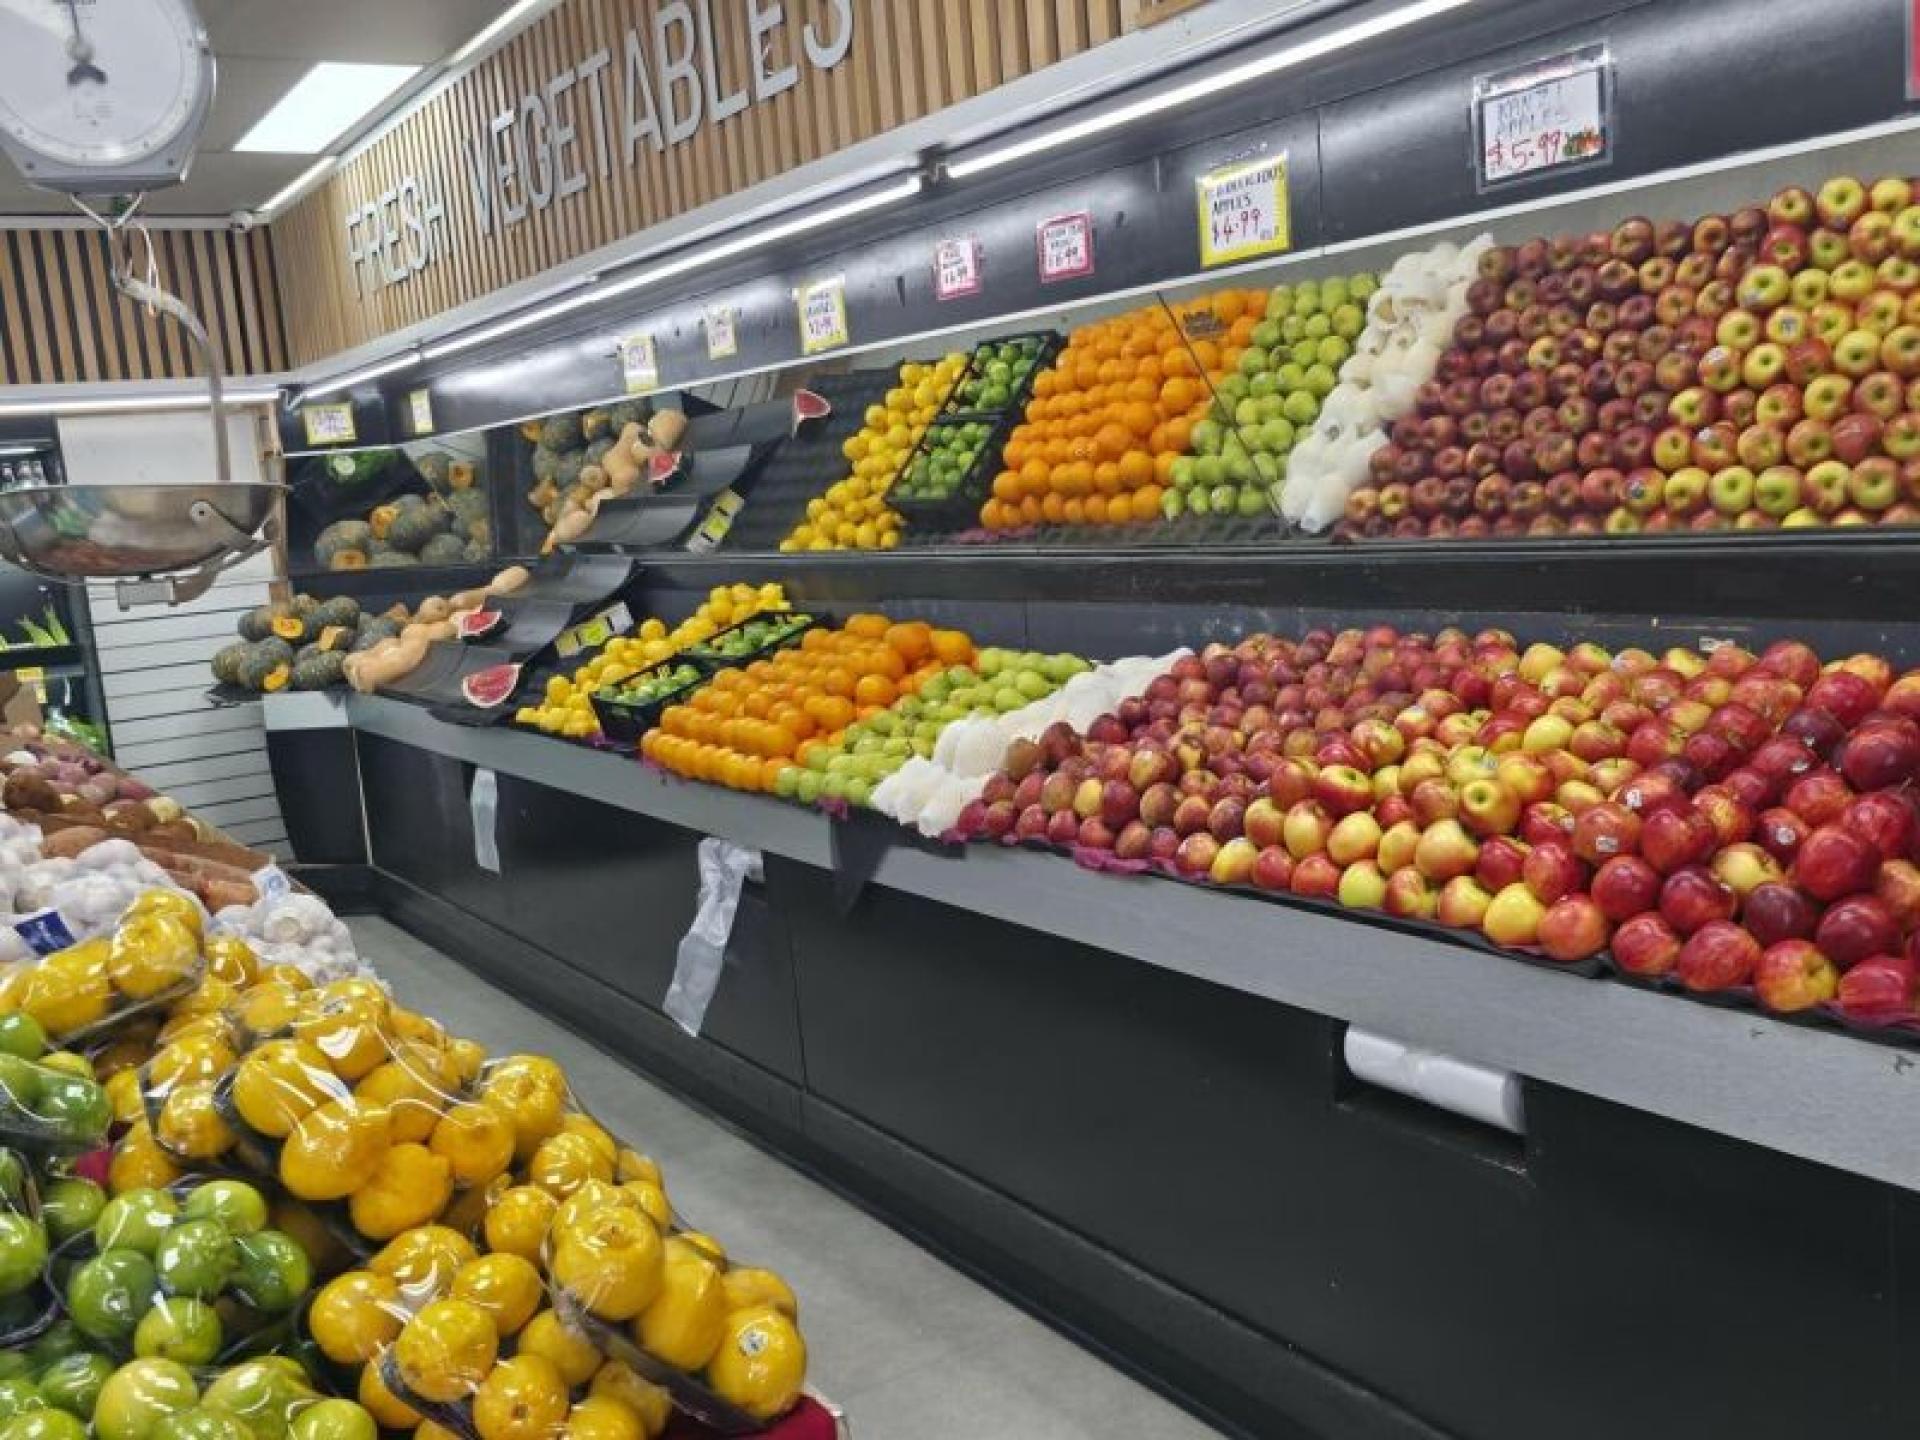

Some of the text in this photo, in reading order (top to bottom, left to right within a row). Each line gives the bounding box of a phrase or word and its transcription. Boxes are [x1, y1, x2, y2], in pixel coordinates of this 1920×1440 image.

[1487, 129, 1562, 170] $5.99
[345, 176, 454, 300] FRESH
[1212, 208, 1263, 247] $4.99
